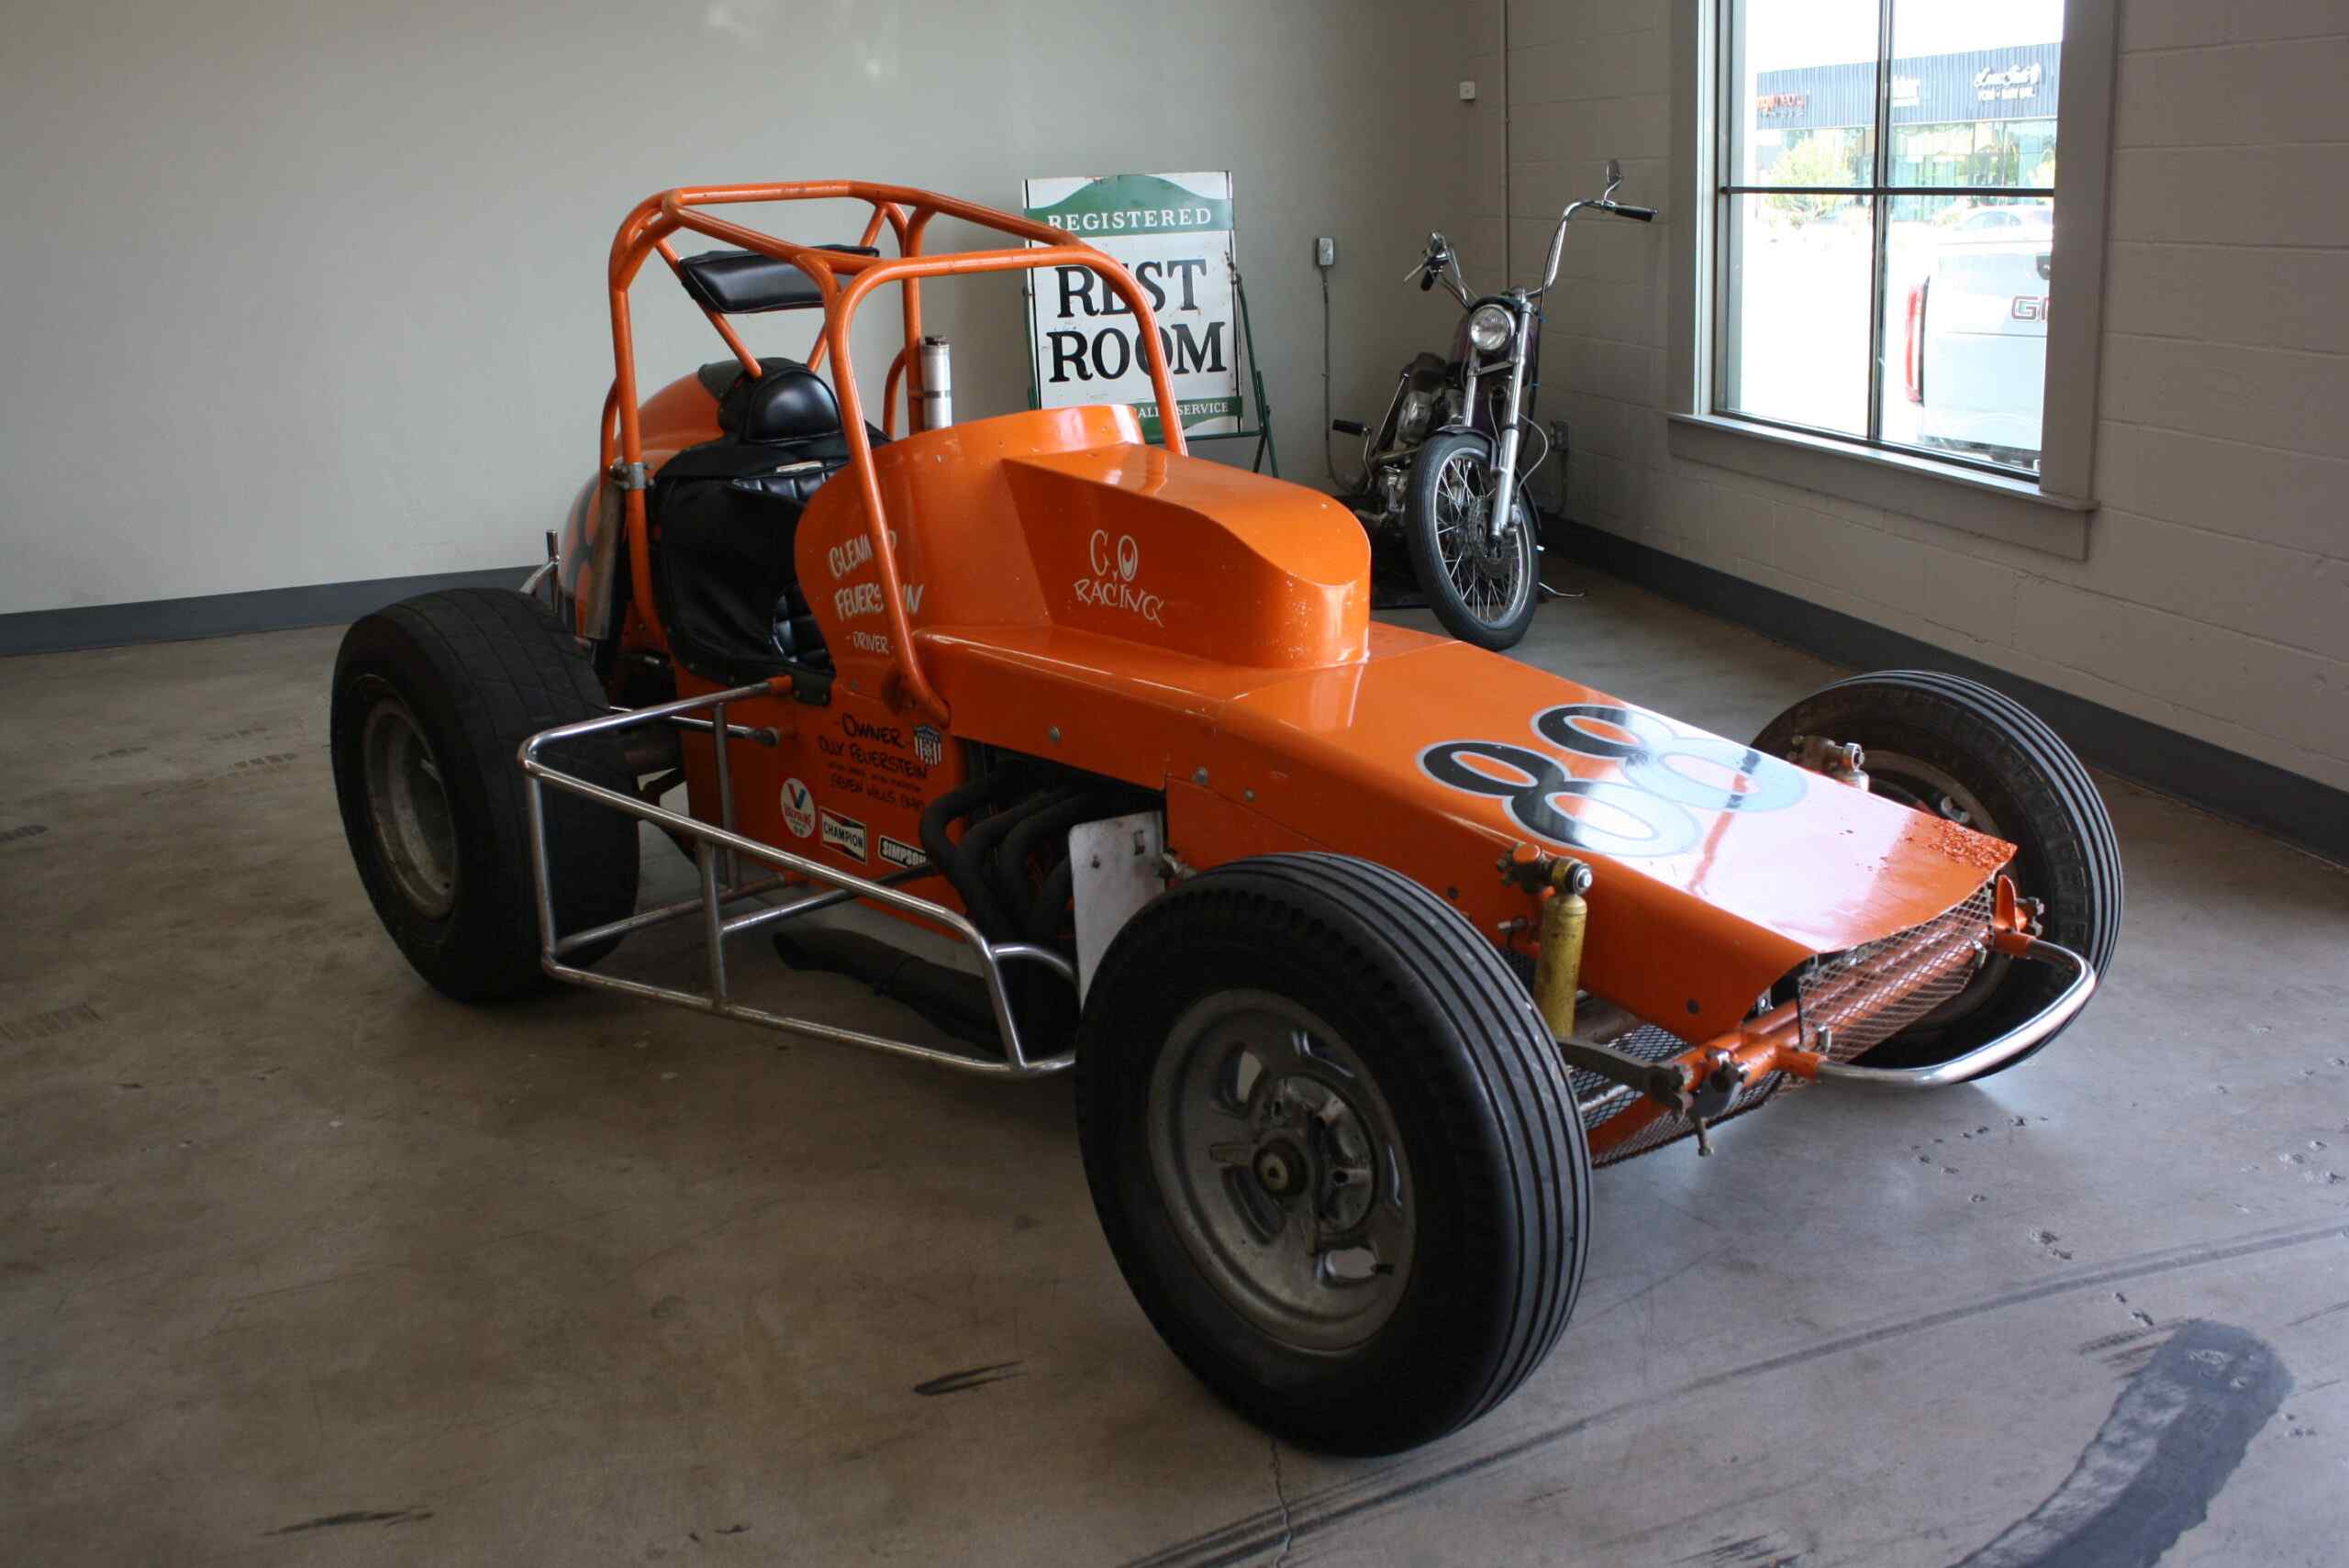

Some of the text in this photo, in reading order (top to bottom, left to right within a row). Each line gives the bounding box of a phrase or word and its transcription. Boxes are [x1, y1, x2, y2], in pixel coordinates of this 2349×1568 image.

[1047, 207, 1212, 231] REGISTERED
[1055, 259, 1208, 318] REST
[1046, 321, 1228, 384] ROOM
[1177, 402, 1229, 416] SERVICE
[834, 583, 925, 622] FEUERSIN
[1073, 578, 1165, 628] RACING
[841, 712, 906, 749] OWNER
[1415, 703, 1809, 858] 88
[823, 821, 864, 848] CHAMPION
